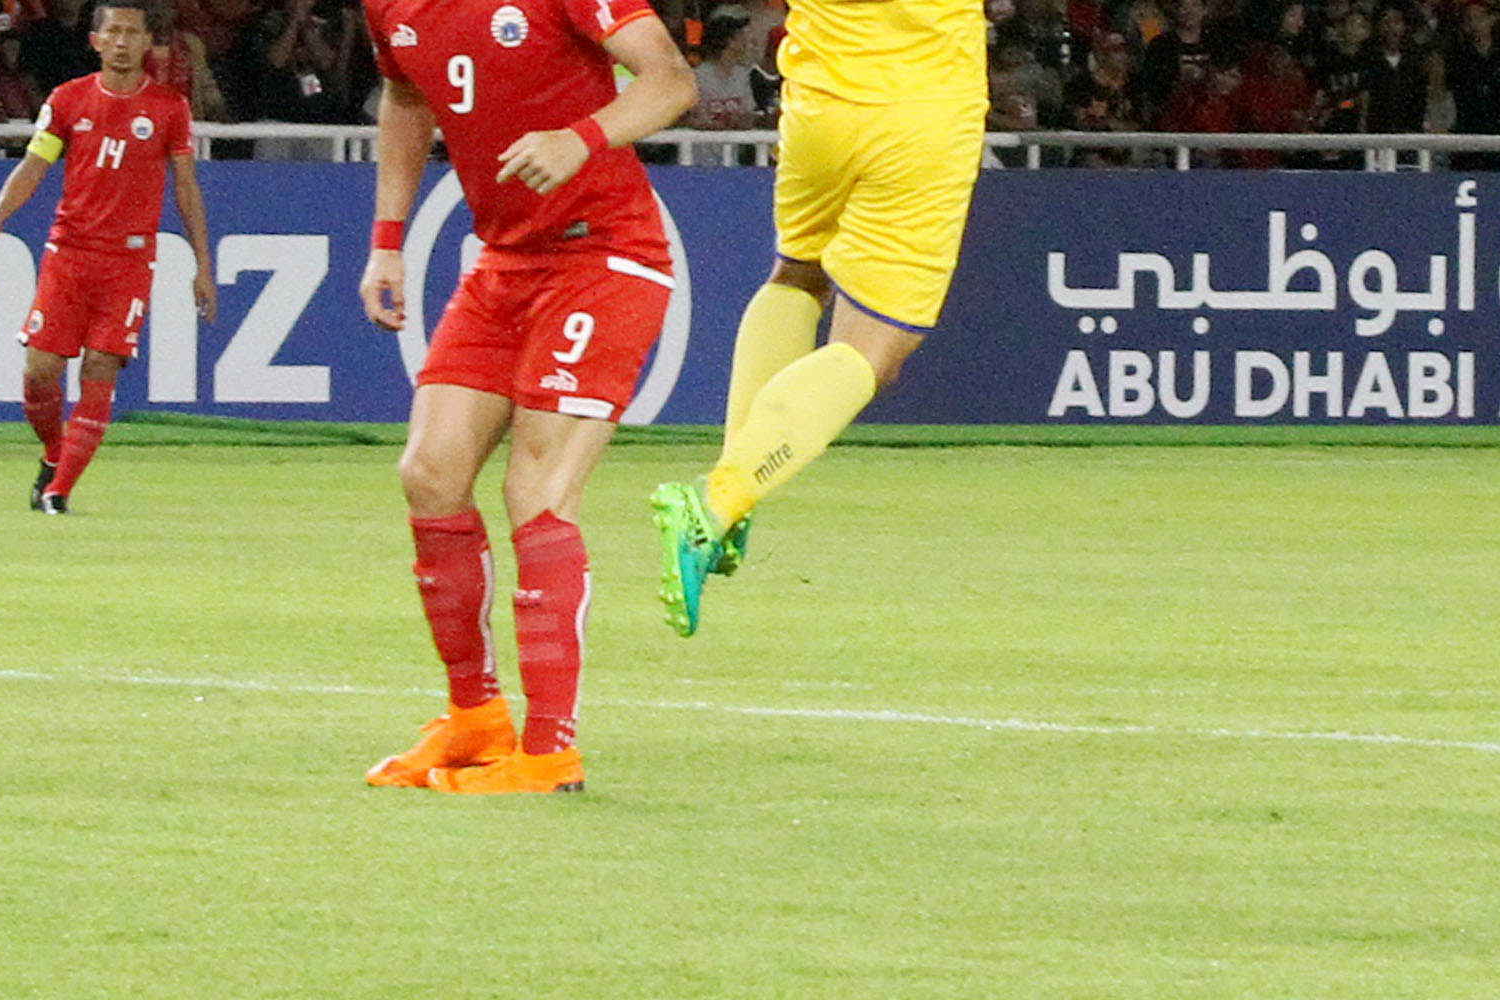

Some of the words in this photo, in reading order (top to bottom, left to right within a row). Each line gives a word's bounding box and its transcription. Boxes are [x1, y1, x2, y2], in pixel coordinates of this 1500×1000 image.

[447, 54, 475, 114] 9
[96, 136, 127, 170] 14
[552, 311, 596, 365] 9
[1047, 350, 1211, 418] ABU
[1234, 350, 1476, 418] DHABI
[752, 442, 793, 485] mitre
